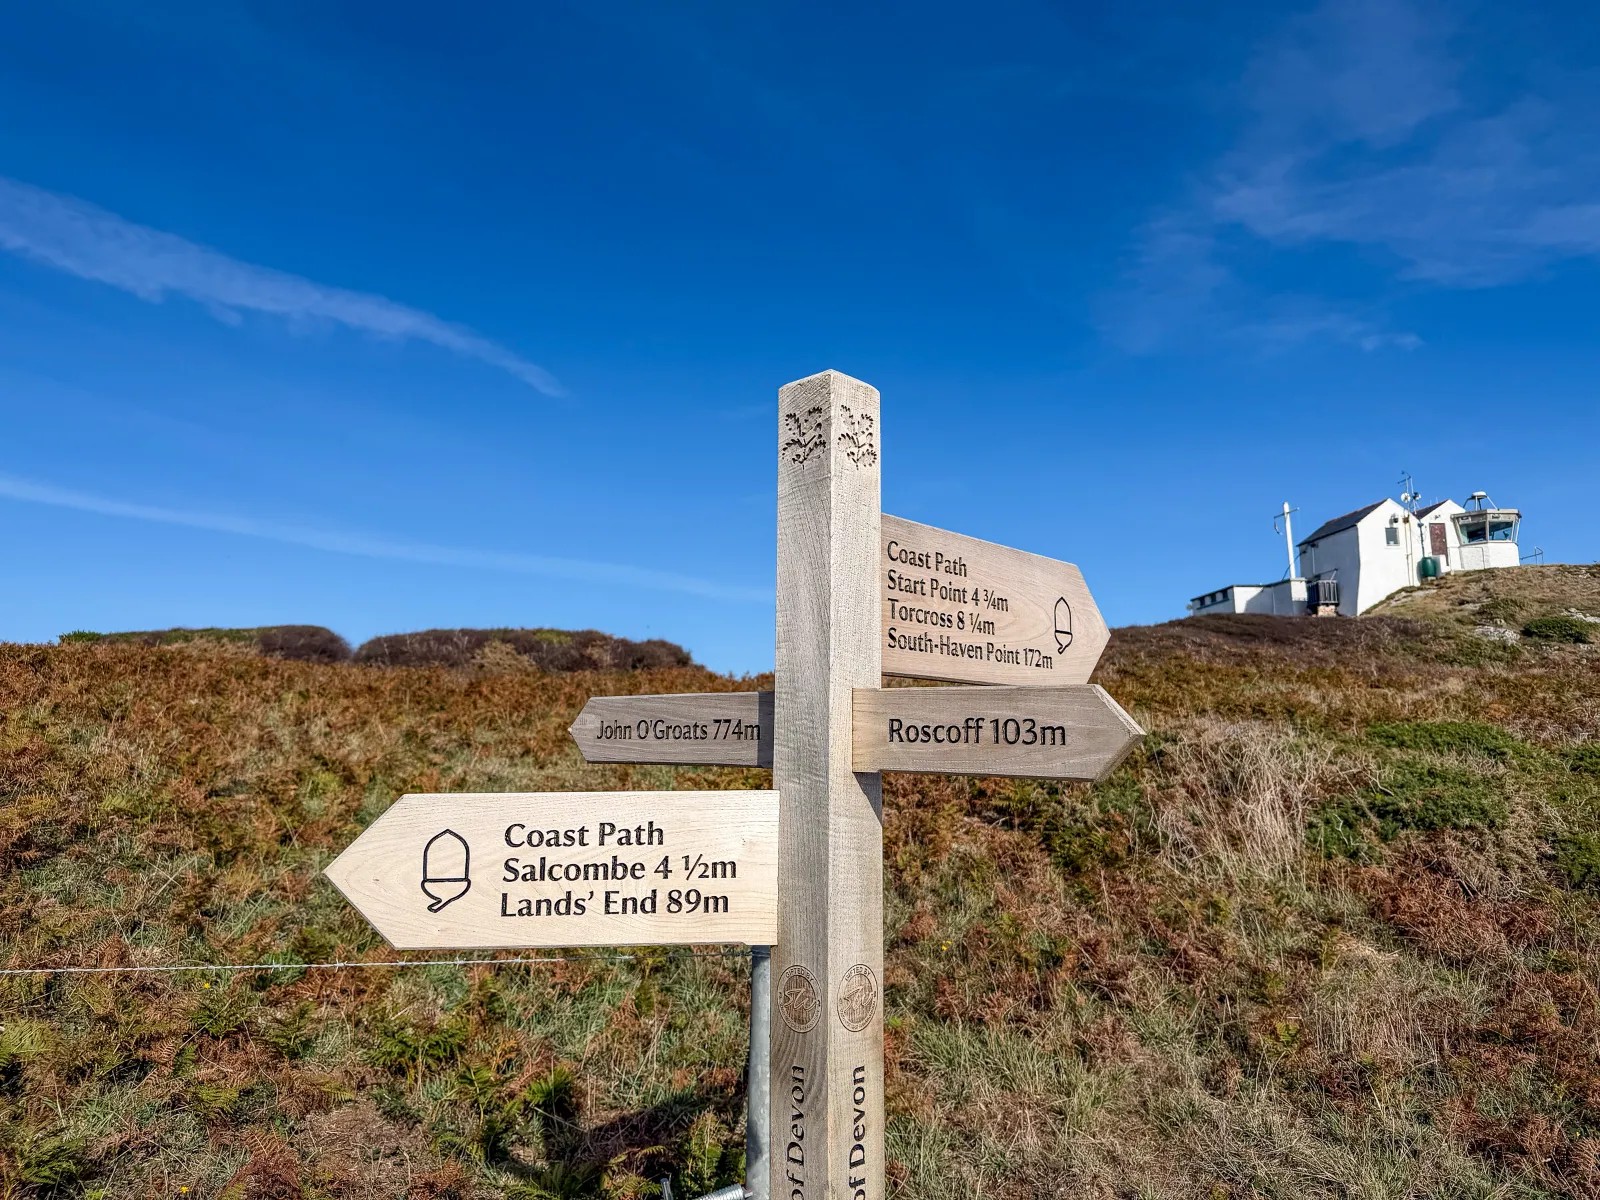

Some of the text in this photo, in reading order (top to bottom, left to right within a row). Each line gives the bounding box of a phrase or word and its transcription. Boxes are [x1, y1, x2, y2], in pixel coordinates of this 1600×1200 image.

[887, 541, 968, 578] Coast Path
[887, 569, 926, 596] Start
[930, 578, 968, 604] Point
[971, 588, 981, 606] 4
[887, 598, 953, 629] Torcross
[956, 611, 965, 630] 8
[887, 627, 1053, 670] South-Haven Point 172m
[596, 719, 761, 741] John O'Groats 774m
[888, 717, 1066, 746] Roscoff 103m
[504, 821, 664, 848] Coast Path
[502, 855, 646, 883] Salcombe
[653, 855, 673, 880] 4
[603, 888, 658, 915] End
[666, 888, 729, 914] 89m
[787, 1066, 804, 1167] Devon
[849, 1066, 866, 1169] Devon
